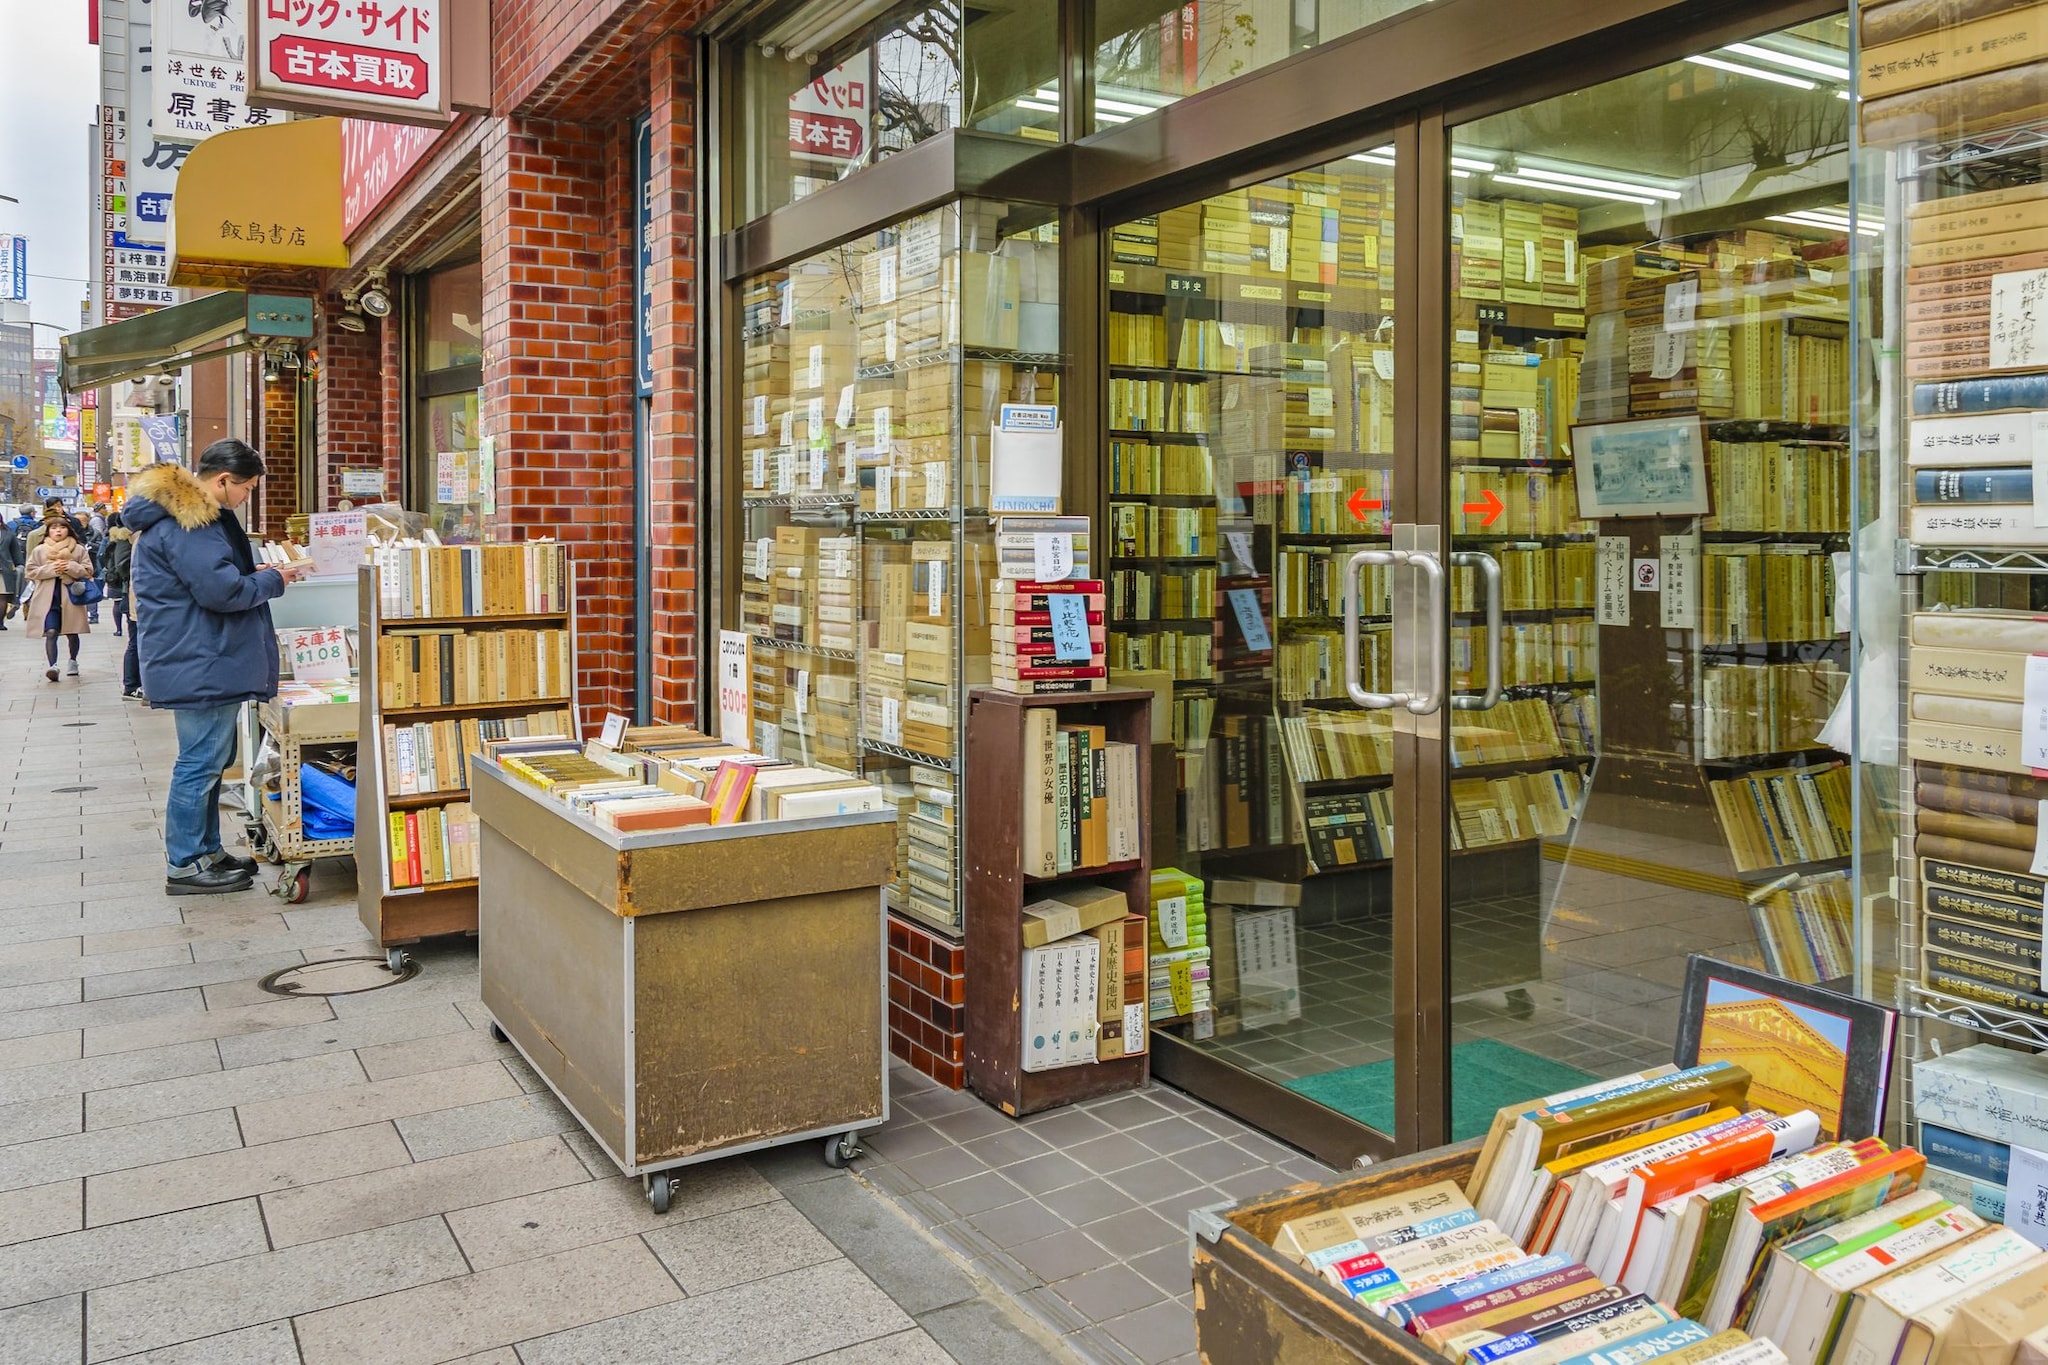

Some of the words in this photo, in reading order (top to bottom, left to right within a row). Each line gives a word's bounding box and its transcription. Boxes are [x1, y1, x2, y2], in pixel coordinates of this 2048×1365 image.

[284, 46, 415, 90] 古本買取
[183, 78, 217, 89] UKIYOE
[167, 92, 272, 125] 原書房
[176, 119, 213, 132] HARA
[220, 219, 306, 247] 飯島書店
[119, 287, 173, 301] 夢野書店
[1171, 279, 1201, 292] 西洋史
[1479, 309, 1504, 320] 西洋史
[1051, 537, 1061, 572] 高松宮日記
[1616, 541, 1625, 560] 中国
[1671, 542, 1680, 561] 日本
[1617, 566, 1626, 590] インド
[295, 629, 341, 649] 文庫本
[296, 646, 340, 663] ¥108
[1043, 740, 1055, 805] 世界の女優
[1058, 763, 1071, 830] 歴史の読み方
[1170, 902, 1179, 935] 日本の近代
[1055, 952, 1063, 1007] 日本歴史大事典
[1073, 950, 1081, 1004] 日本歴史大事典
[1105, 929, 1118, 1011] 日本歴史地図
[1408, 1191, 1451, 1214] 昨日の旅
